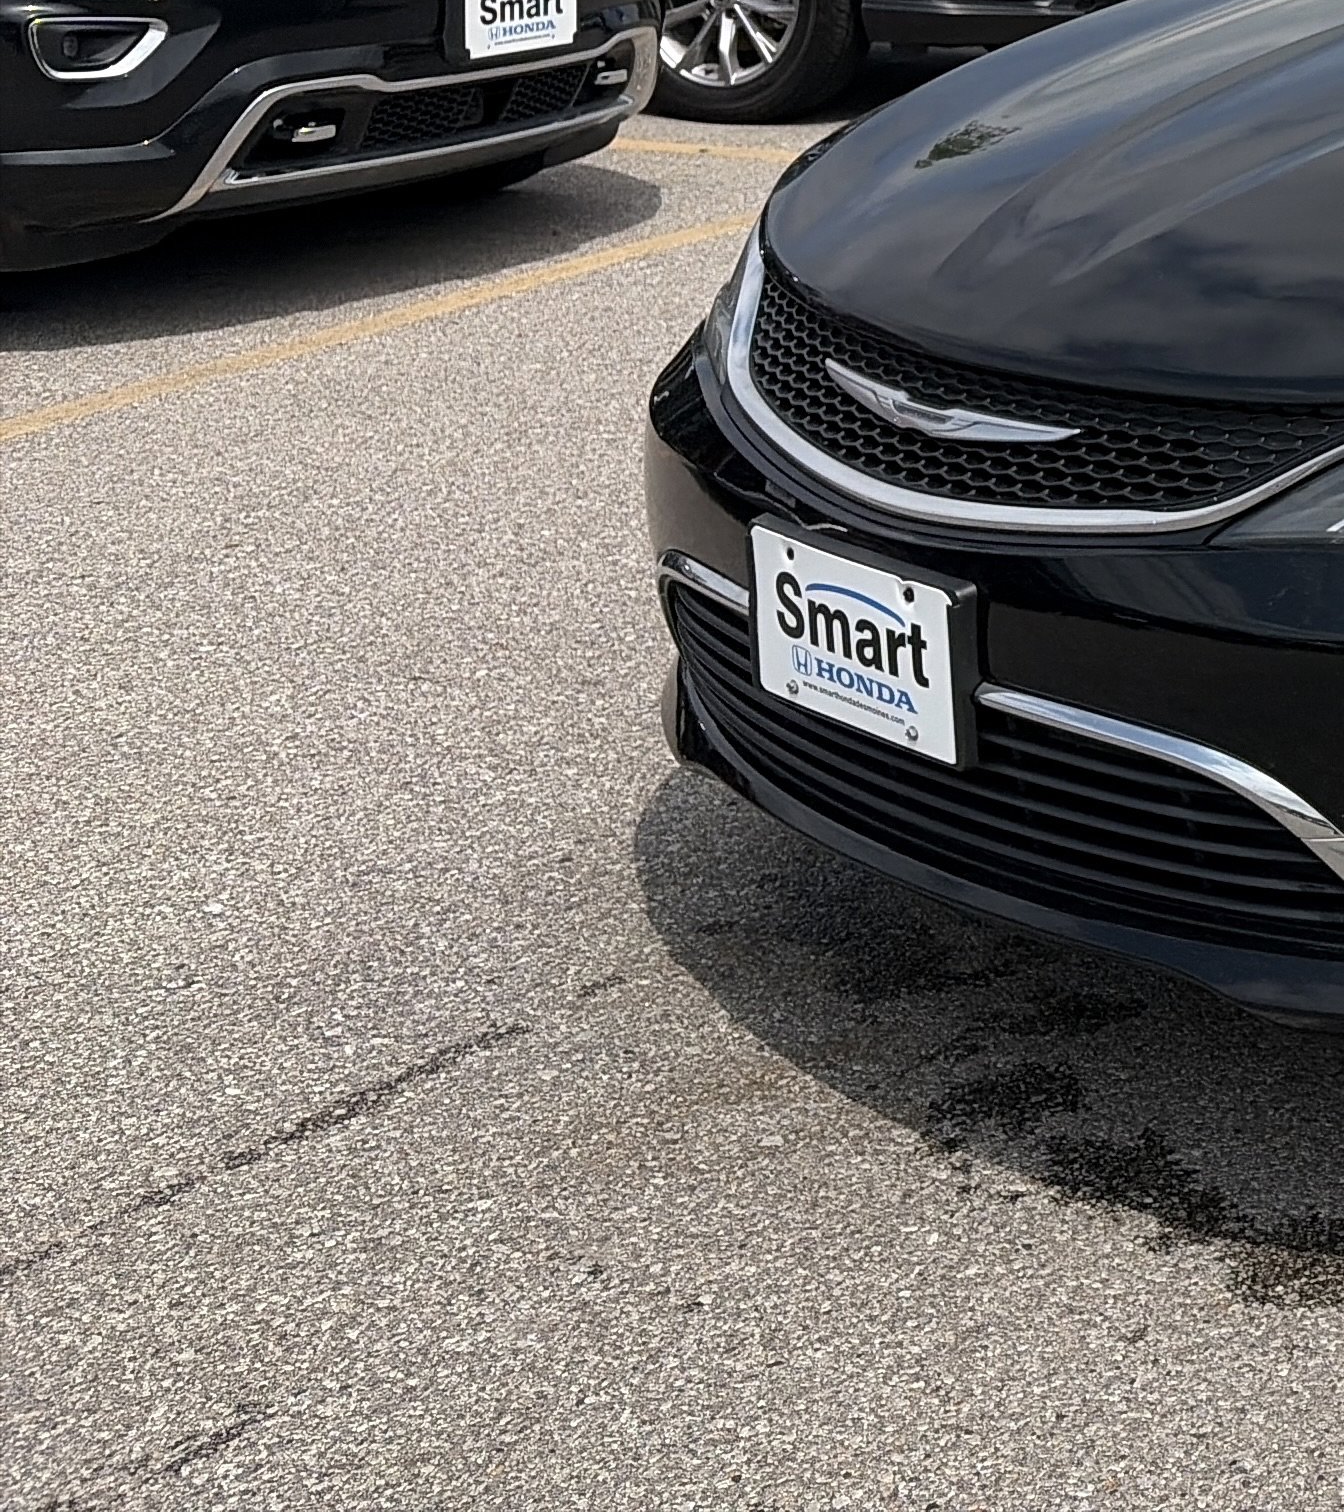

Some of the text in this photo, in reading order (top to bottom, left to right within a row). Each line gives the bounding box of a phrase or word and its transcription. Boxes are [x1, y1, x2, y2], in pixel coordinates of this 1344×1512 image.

[502, 19, 556, 37] HONDA
[775, 571, 930, 689] Smart
[814, 656, 919, 715] HONDA
